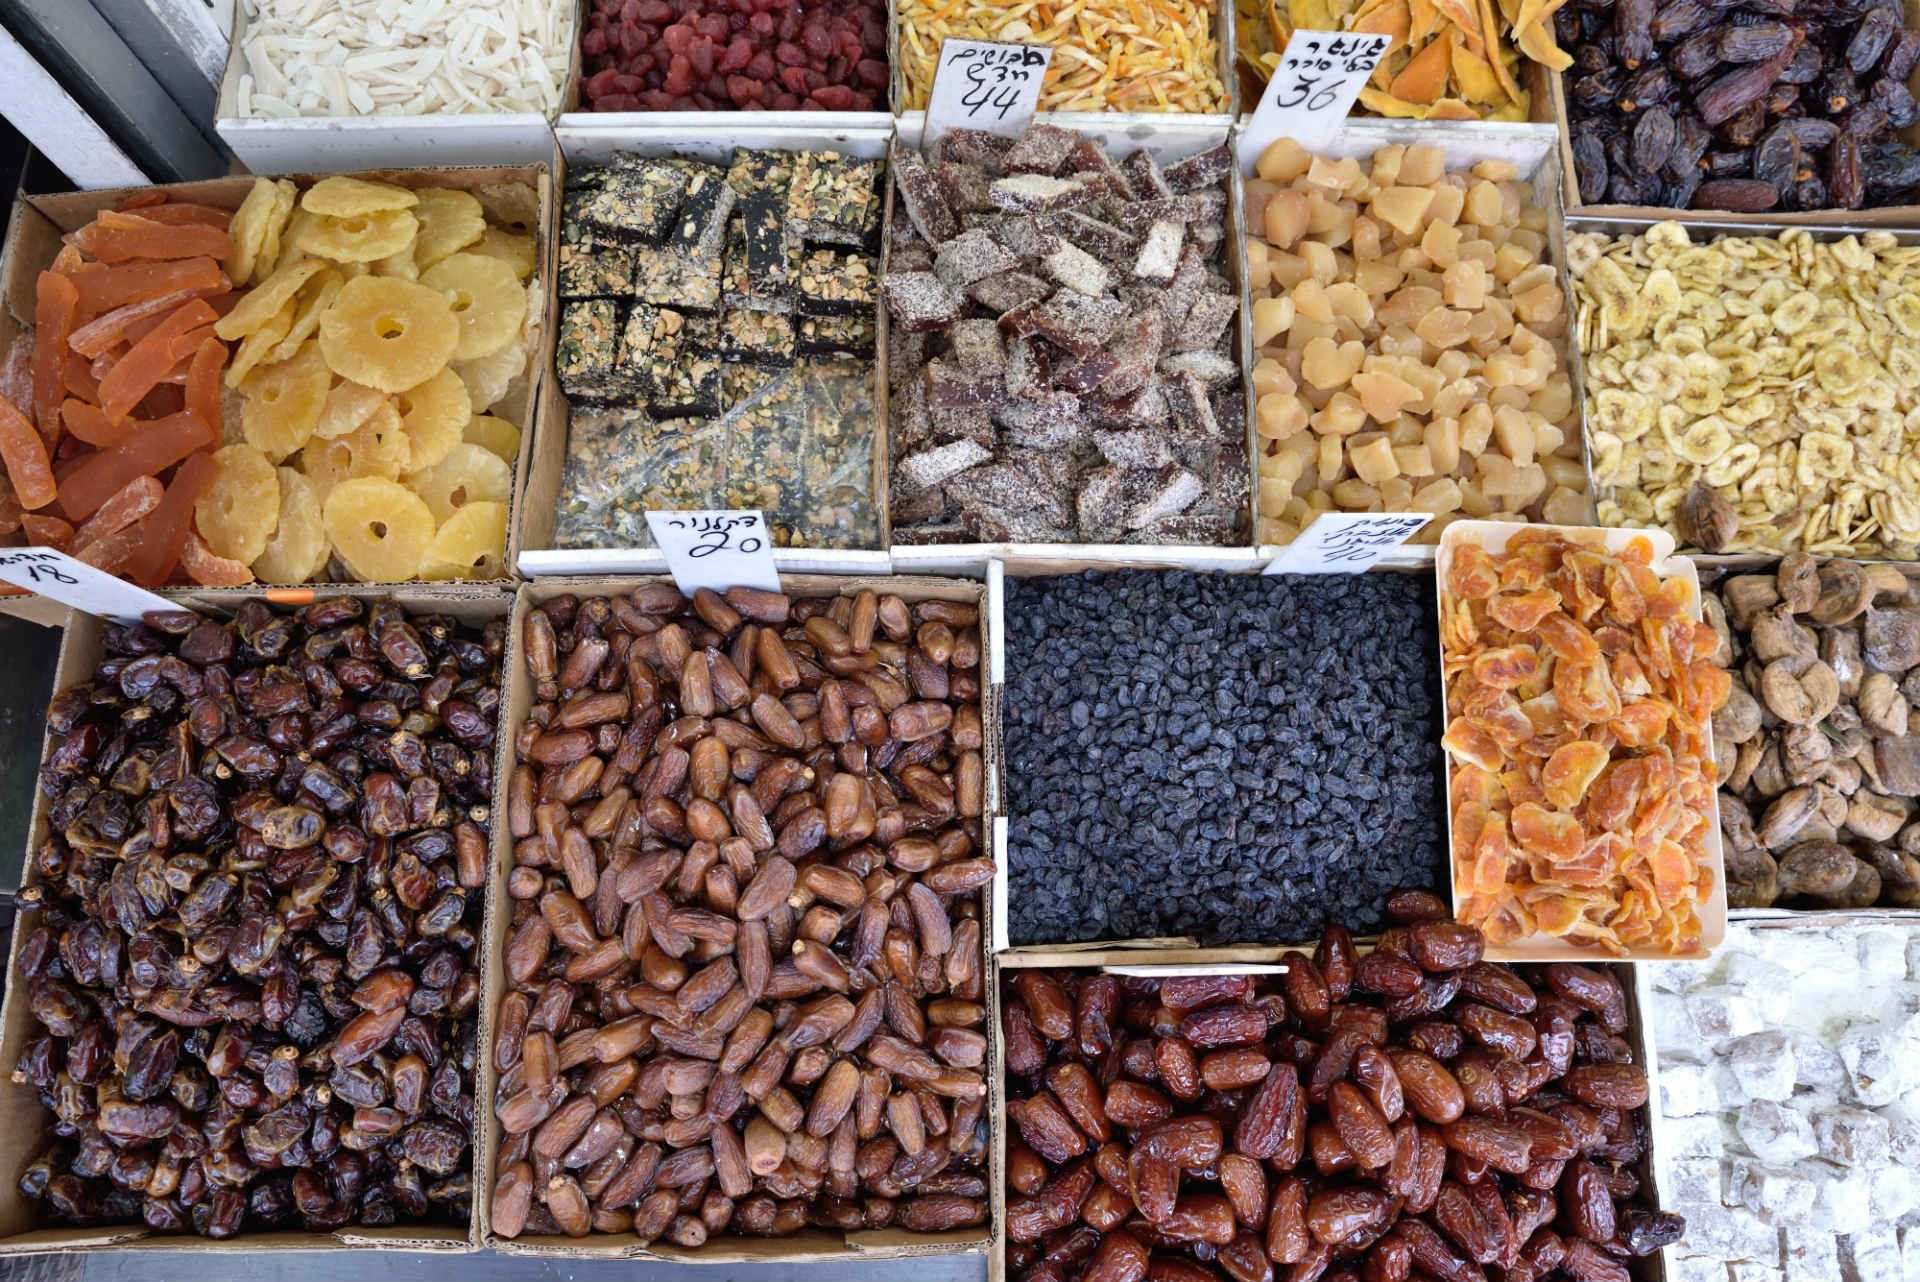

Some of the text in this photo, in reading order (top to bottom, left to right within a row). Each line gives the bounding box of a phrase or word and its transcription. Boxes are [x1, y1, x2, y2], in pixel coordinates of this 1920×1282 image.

[962, 81, 1021, 120] 44
[1277, 74, 1346, 111] 36
[688, 532, 761, 558] 20
[27, 564, 79, 584] 18
